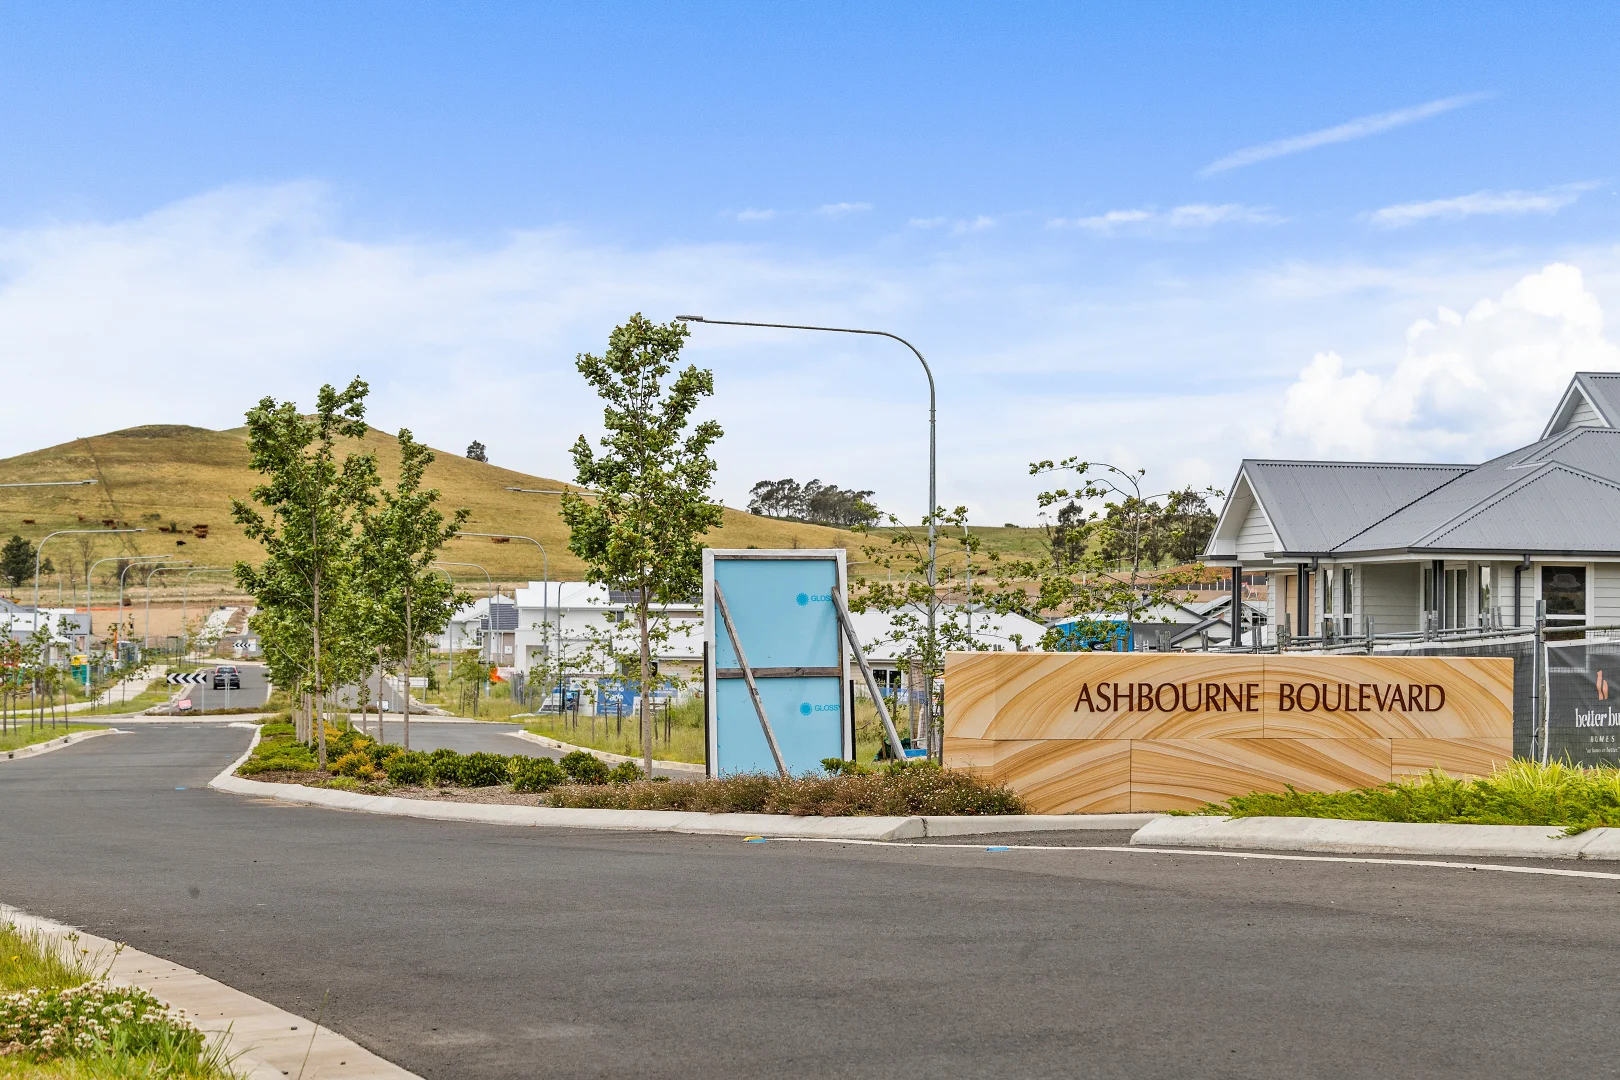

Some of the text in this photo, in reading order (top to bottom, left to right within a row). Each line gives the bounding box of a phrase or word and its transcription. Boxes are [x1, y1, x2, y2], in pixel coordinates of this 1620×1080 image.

[1074, 682, 1446, 713] ASHBOURNE BOULEVARD
[1575, 707, 1607, 728] better
